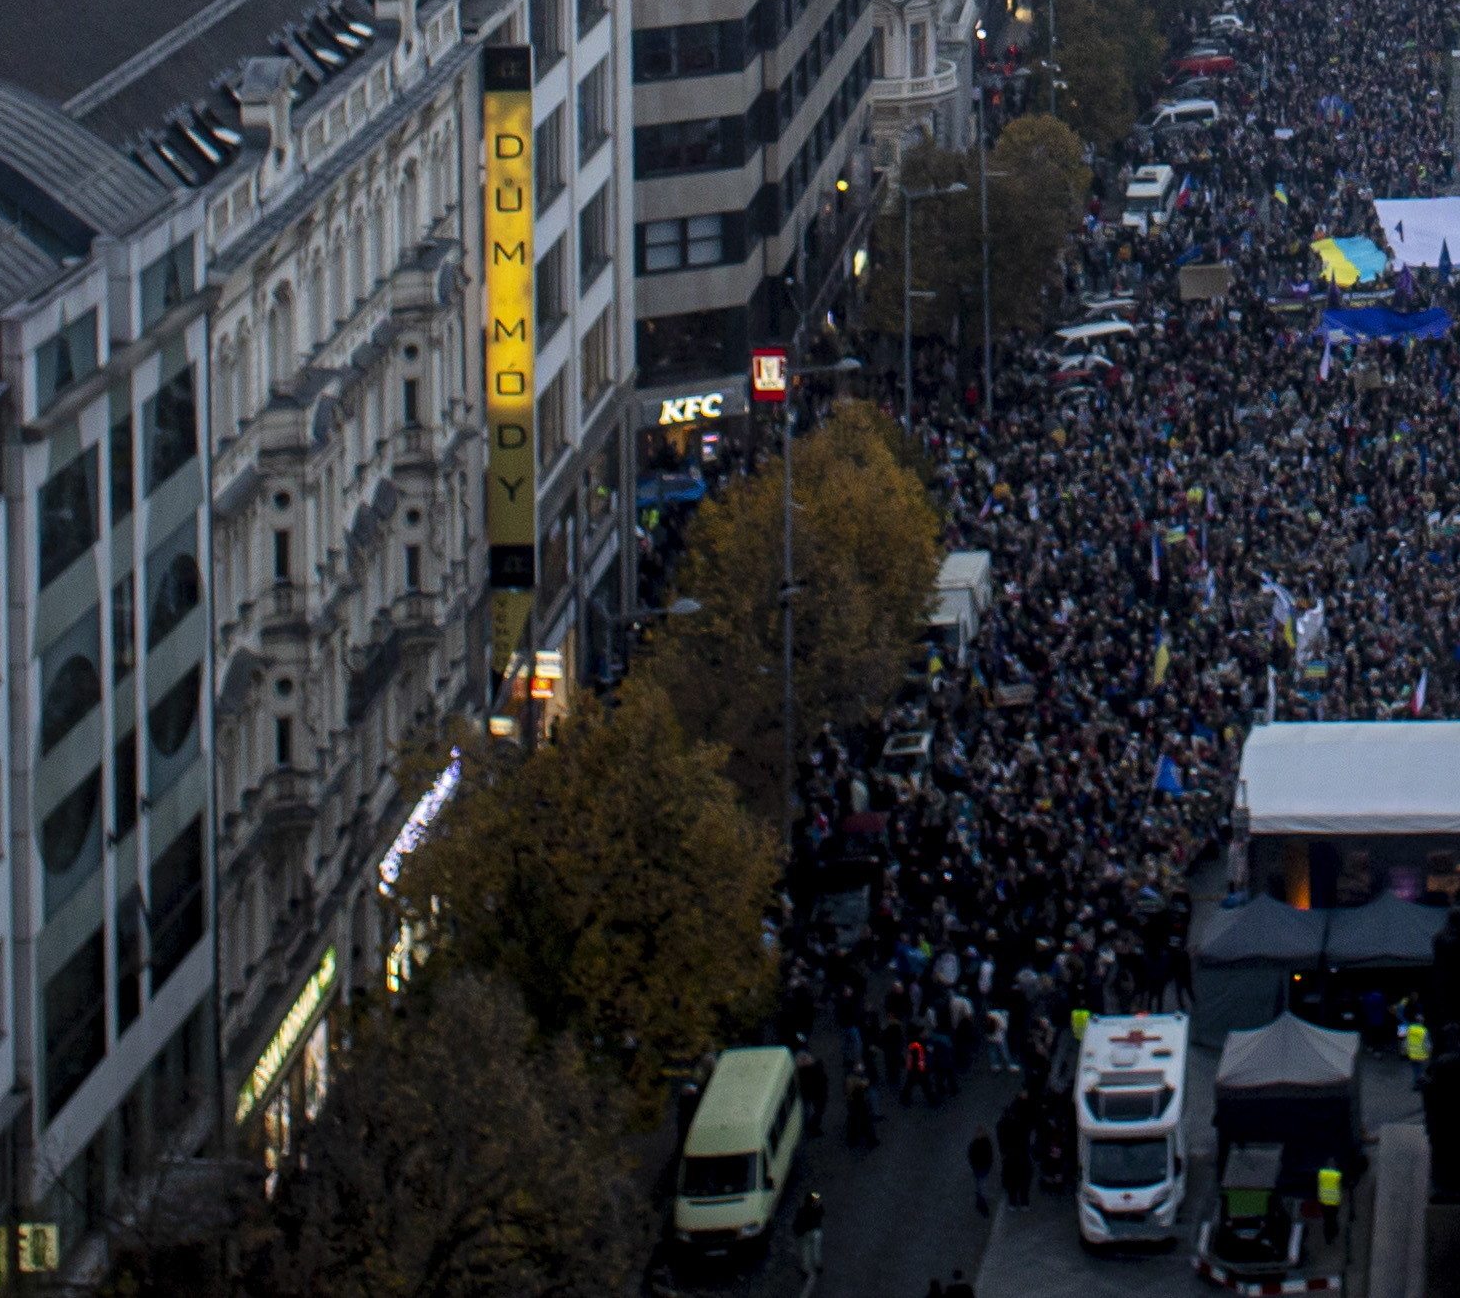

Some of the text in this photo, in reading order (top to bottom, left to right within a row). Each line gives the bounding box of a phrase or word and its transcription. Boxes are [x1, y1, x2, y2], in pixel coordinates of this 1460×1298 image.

[492, 133, 527, 502] DŮM MÓDY
[659, 393, 724, 425] KFC
